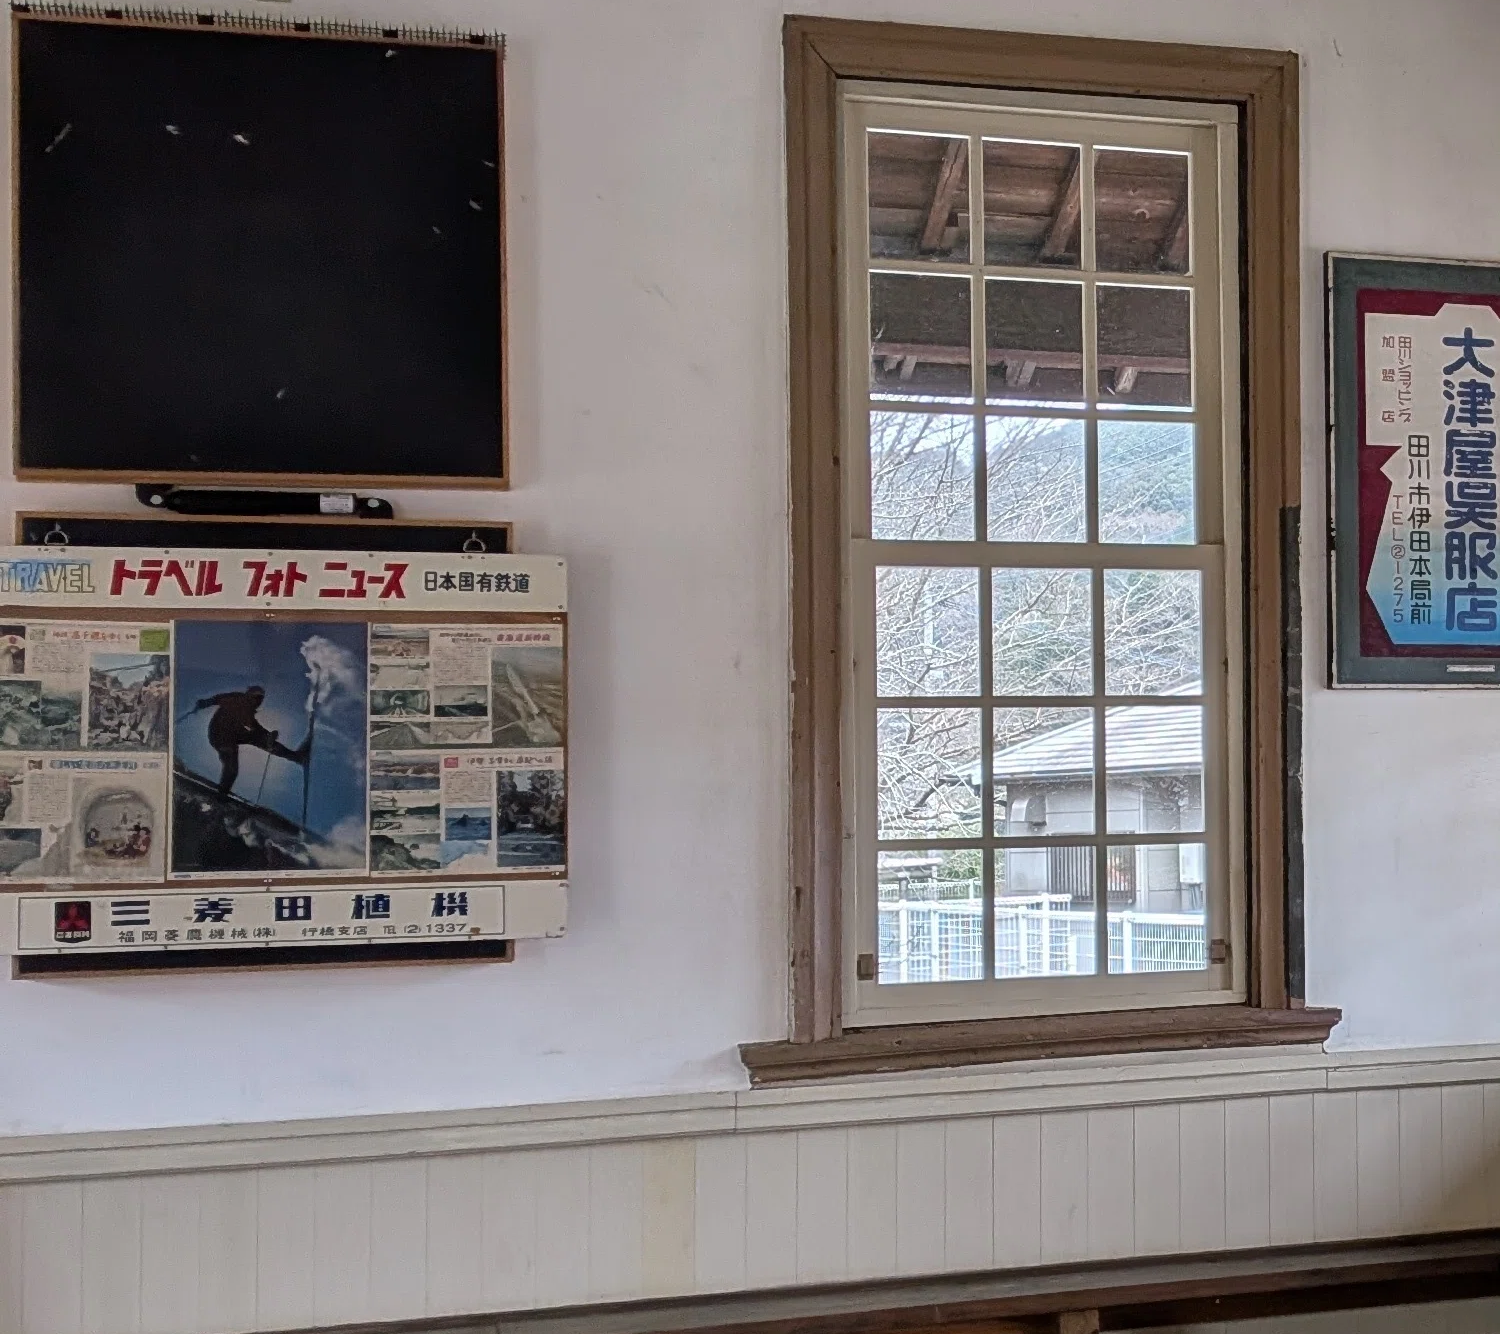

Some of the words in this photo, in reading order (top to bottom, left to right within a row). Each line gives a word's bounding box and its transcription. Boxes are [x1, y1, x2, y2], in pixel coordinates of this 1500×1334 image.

[1382, 335, 1396, 423] 加盟店
[1442, 327, 1499, 633] 大津屋呉服店
[1407, 434, 1433, 625] 田川市伊田本局前
[0, 560, 96, 594] TRAVEL
[109, 558, 223, 597] トラベル
[242, 560, 308, 598] フォト
[318, 561, 410, 599] ニュース
[424, 570, 531, 594] 日本国有鉄道
[110, 891, 469, 927] 三菱田植機
